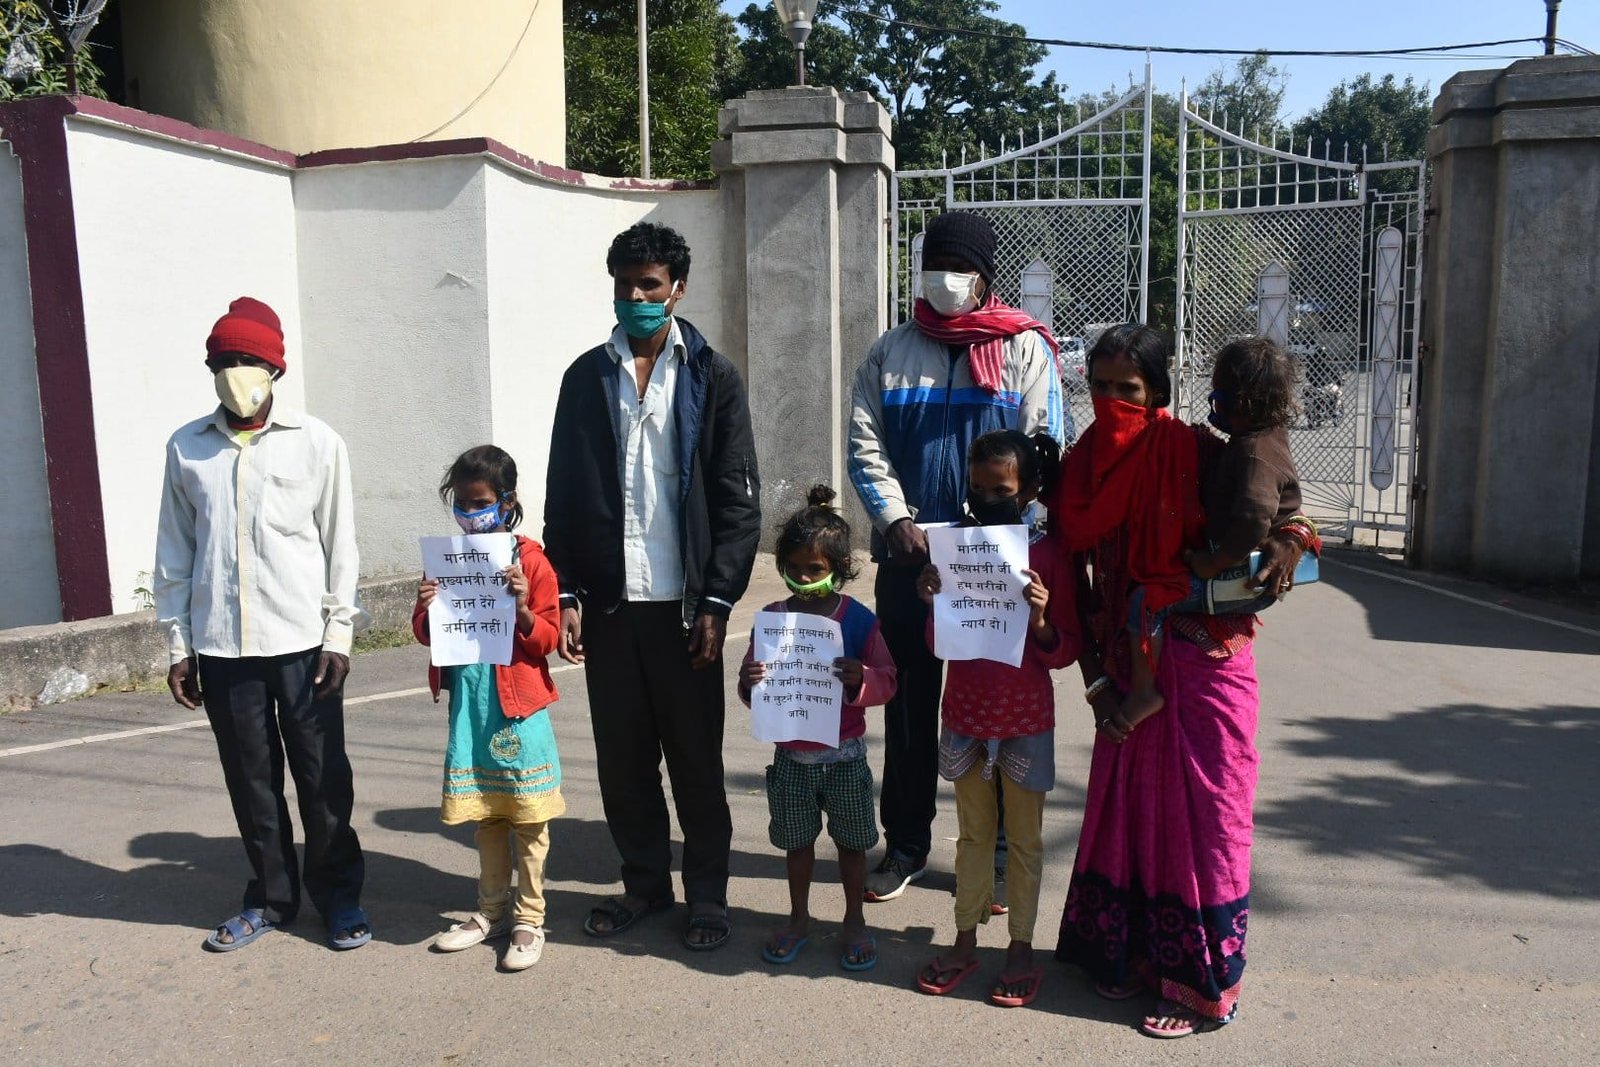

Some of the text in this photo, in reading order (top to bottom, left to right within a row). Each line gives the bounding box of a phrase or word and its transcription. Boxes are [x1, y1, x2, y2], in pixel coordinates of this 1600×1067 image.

[957, 541, 1000, 554] माननीय
[443, 548, 490, 564] माननीय
[948, 562, 1012, 574] मुख्यमंत्री जी
[436, 572, 506, 590] मुख्यमंत्री जी
[957, 581, 972, 592] हम
[451, 594, 496, 609] जान देंगे
[951, 596, 1017, 612] आदिवासी को
[442, 618, 476, 634] जमीन
[961, 618, 986, 629] न्याय
[763, 626, 794, 637] माननीय
[780, 644, 816, 654] जी हमारे
[806, 662, 830, 672] जमीन
[778, 676, 802, 687] जमीन
[763, 692, 770, 702] से
[795, 691, 802, 700] से
[805, 694, 832, 706] बचाया
